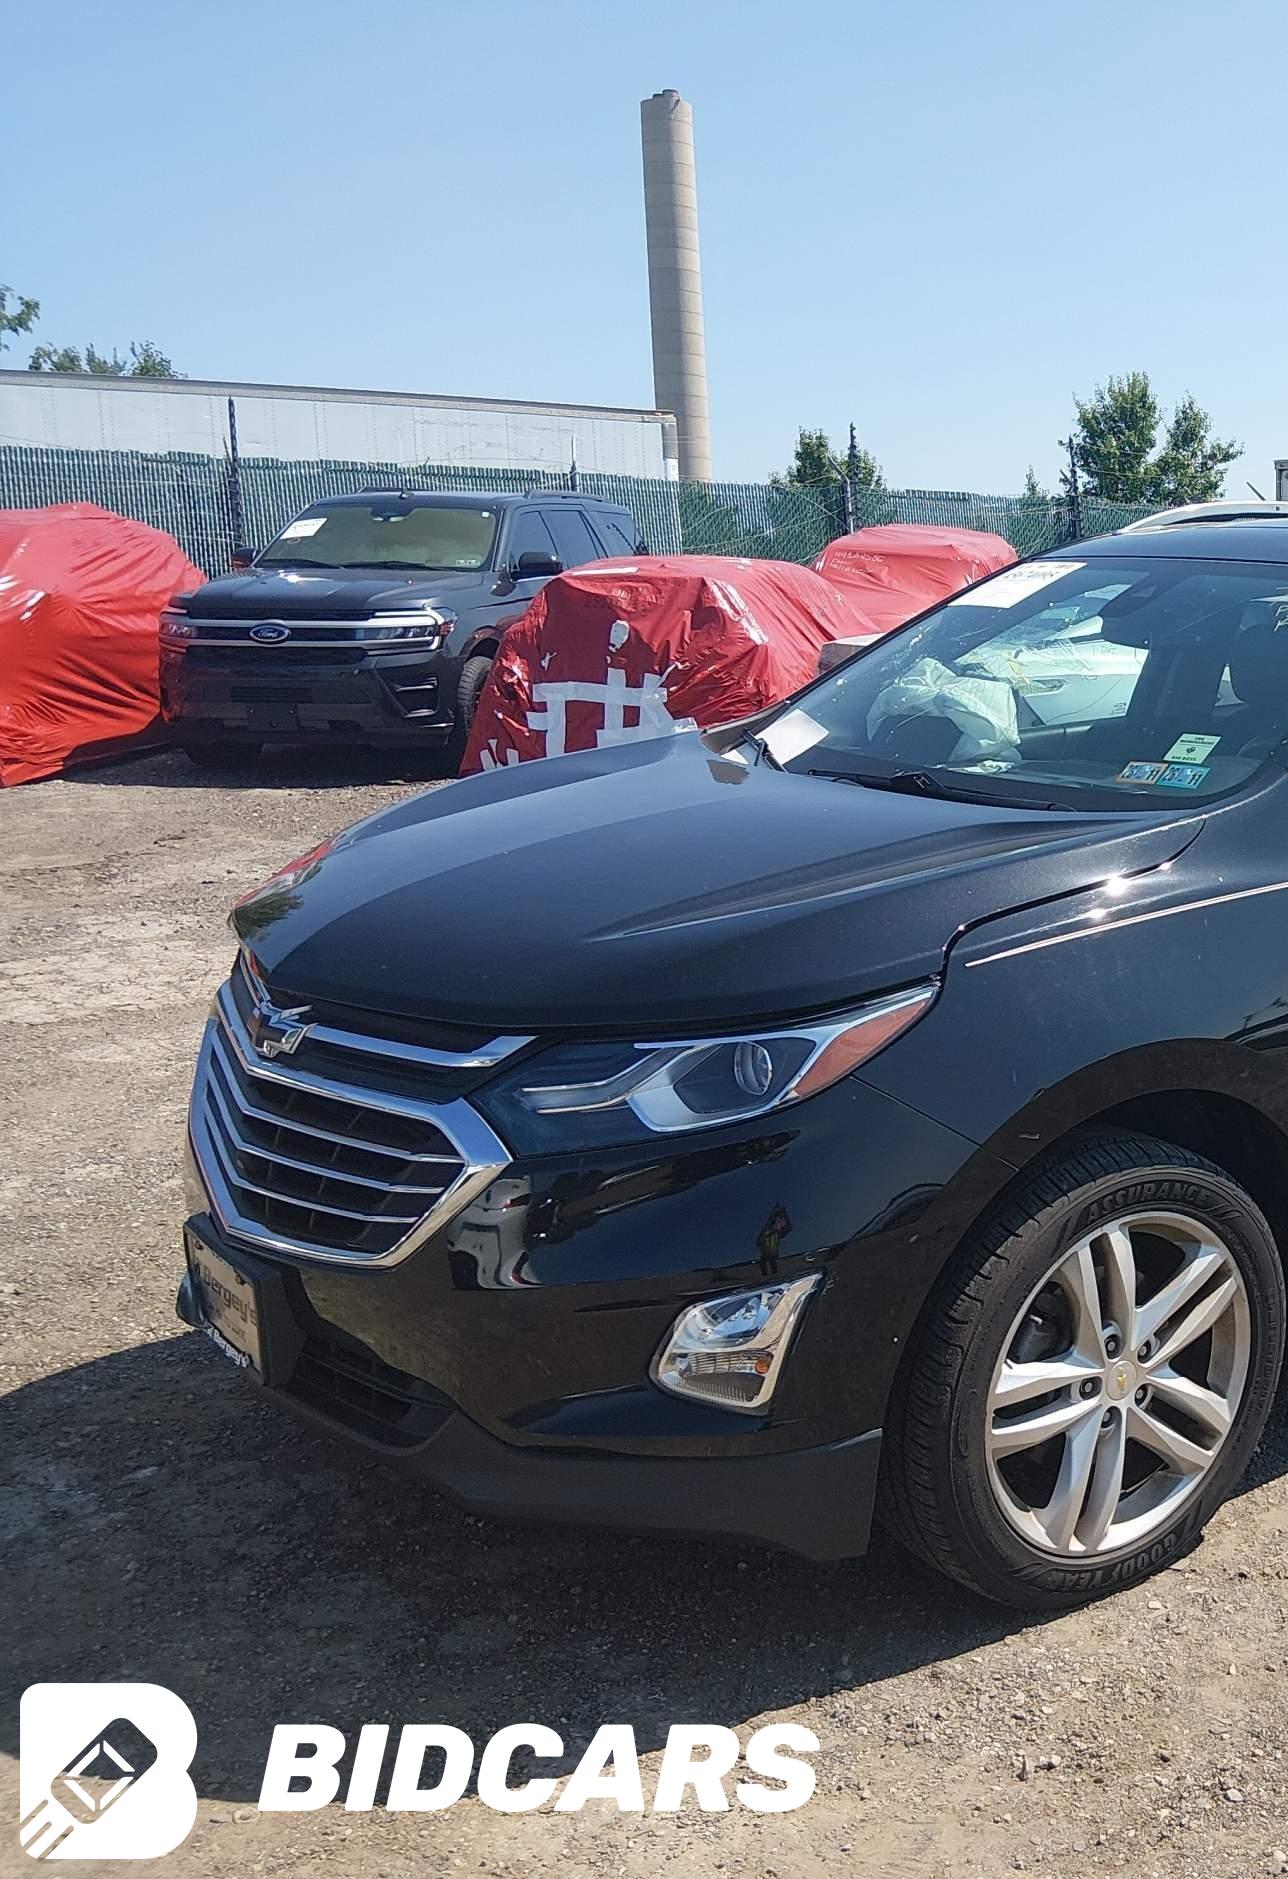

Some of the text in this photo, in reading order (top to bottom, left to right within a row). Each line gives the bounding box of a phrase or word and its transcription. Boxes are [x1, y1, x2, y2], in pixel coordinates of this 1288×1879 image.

[1087, 1182, 1211, 1221] ASSURANCE
[203, 1264, 257, 1327] Bergey's
[213, 1329, 247, 1368] Bergey's
